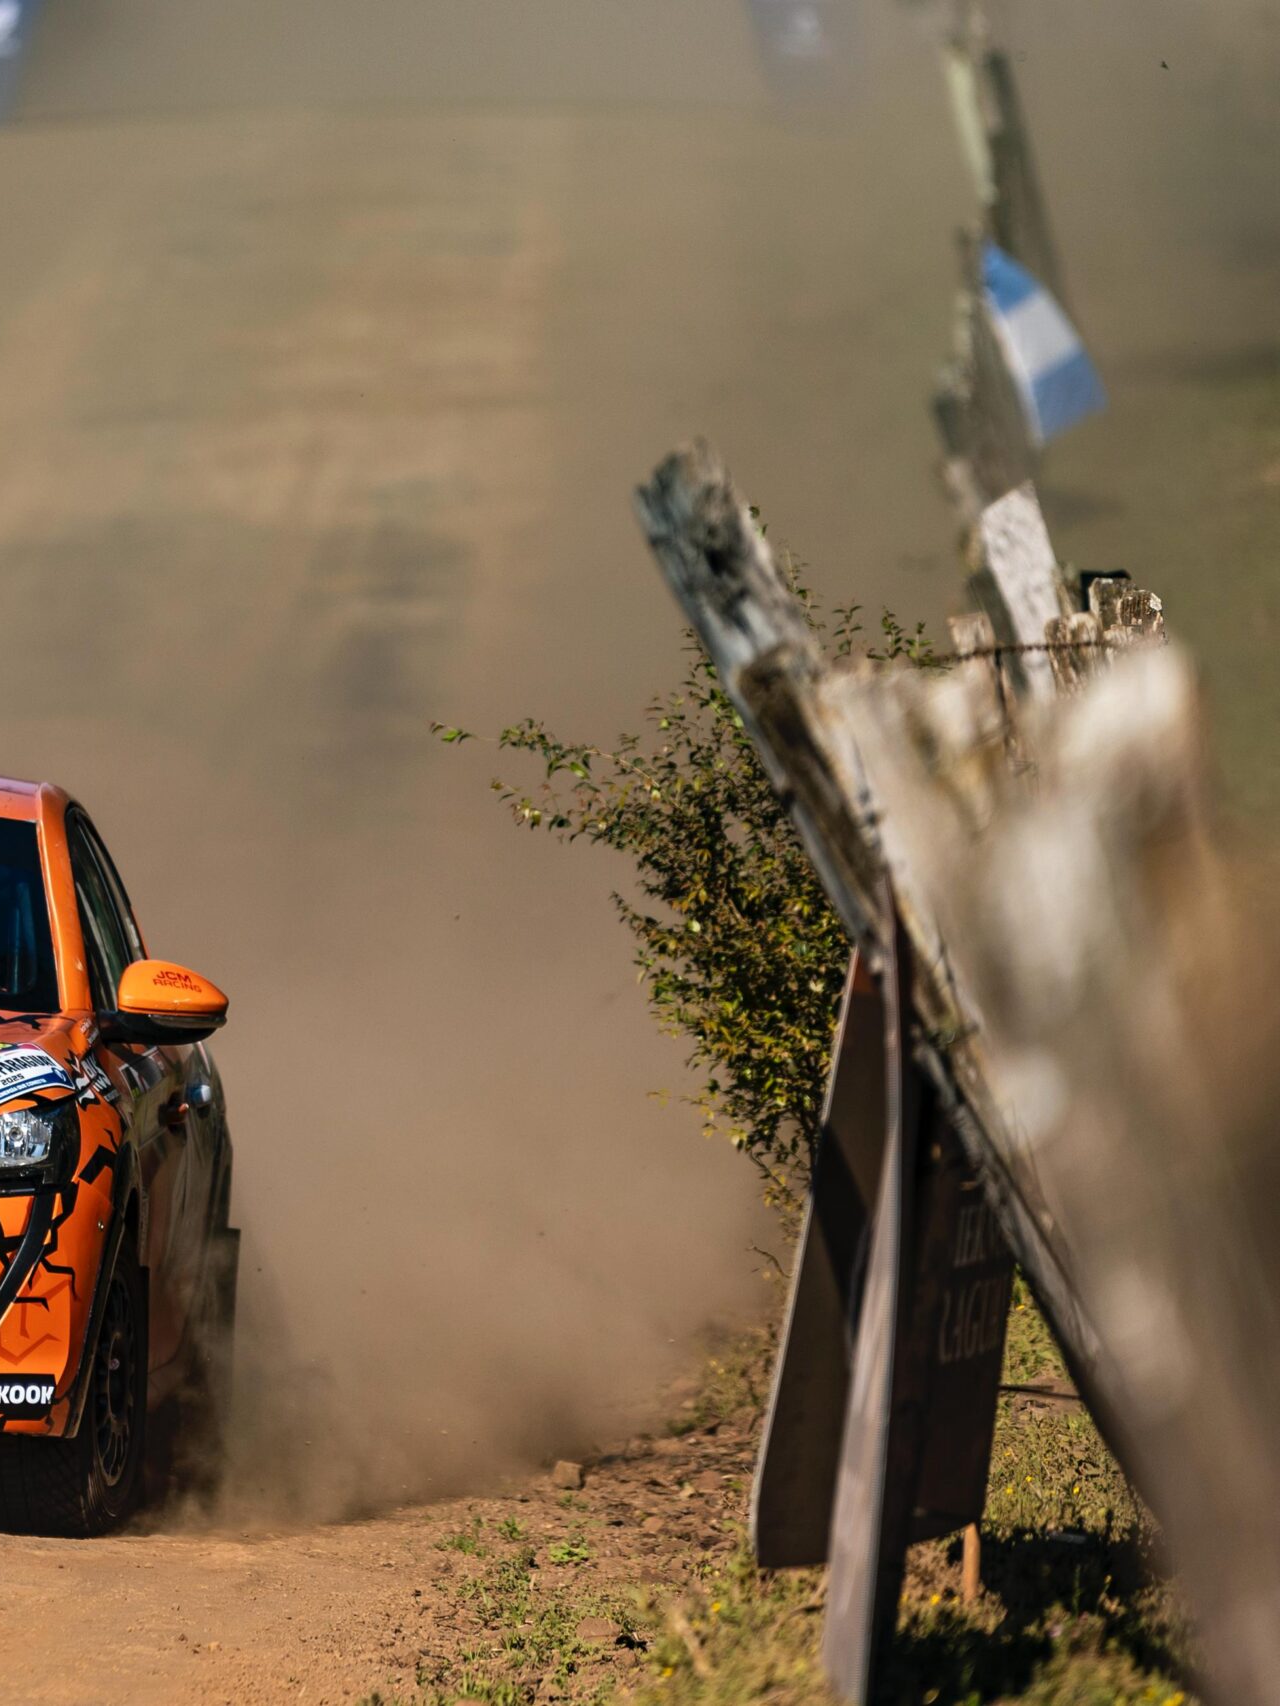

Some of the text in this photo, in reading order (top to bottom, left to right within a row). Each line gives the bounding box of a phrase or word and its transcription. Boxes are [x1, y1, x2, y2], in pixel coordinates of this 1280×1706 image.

[156, 970, 192, 984] JCM
[152, 978, 202, 993] RACING
[1, 1073, 25, 1086] 2025
